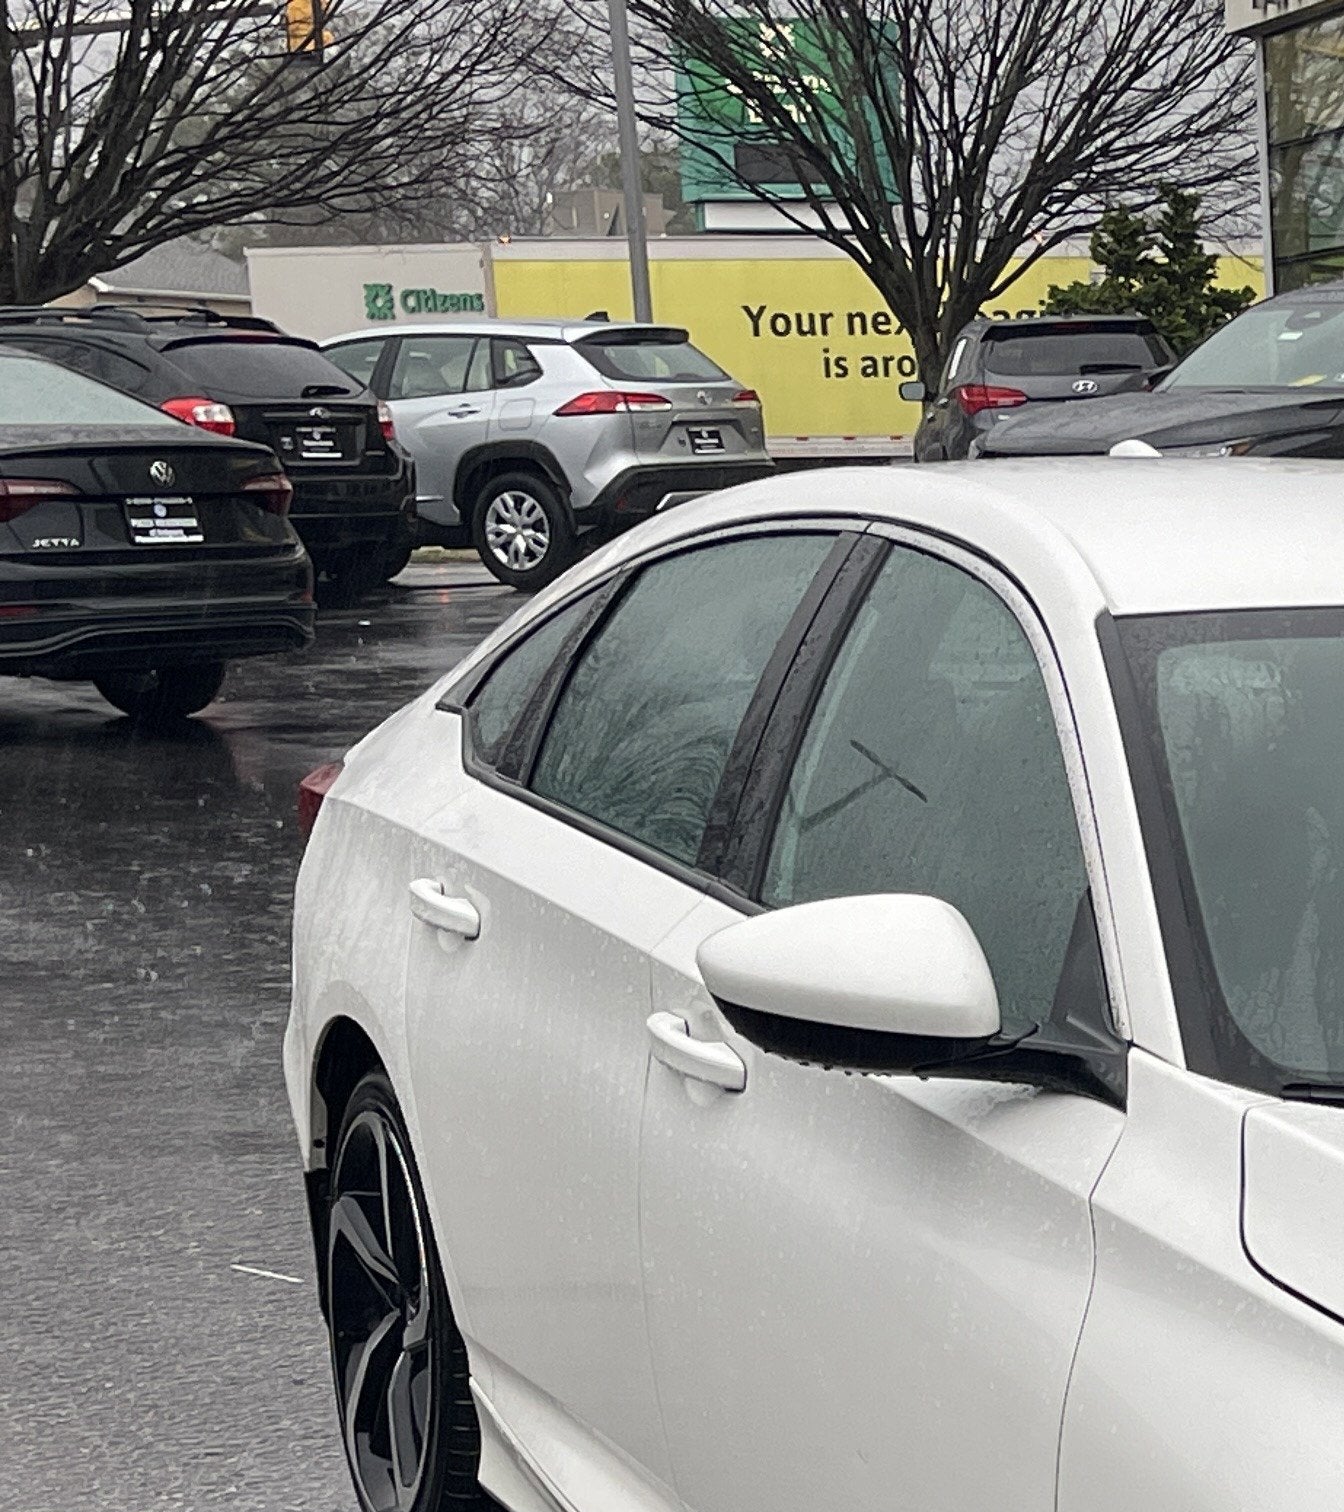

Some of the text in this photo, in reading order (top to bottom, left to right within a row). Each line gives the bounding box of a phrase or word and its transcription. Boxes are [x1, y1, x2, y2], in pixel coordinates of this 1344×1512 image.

[400, 287, 485, 314] Citizens
[741, 305, 833, 337] Your
[823, 347, 849, 379] is
[31, 536, 81, 549] JETTA
